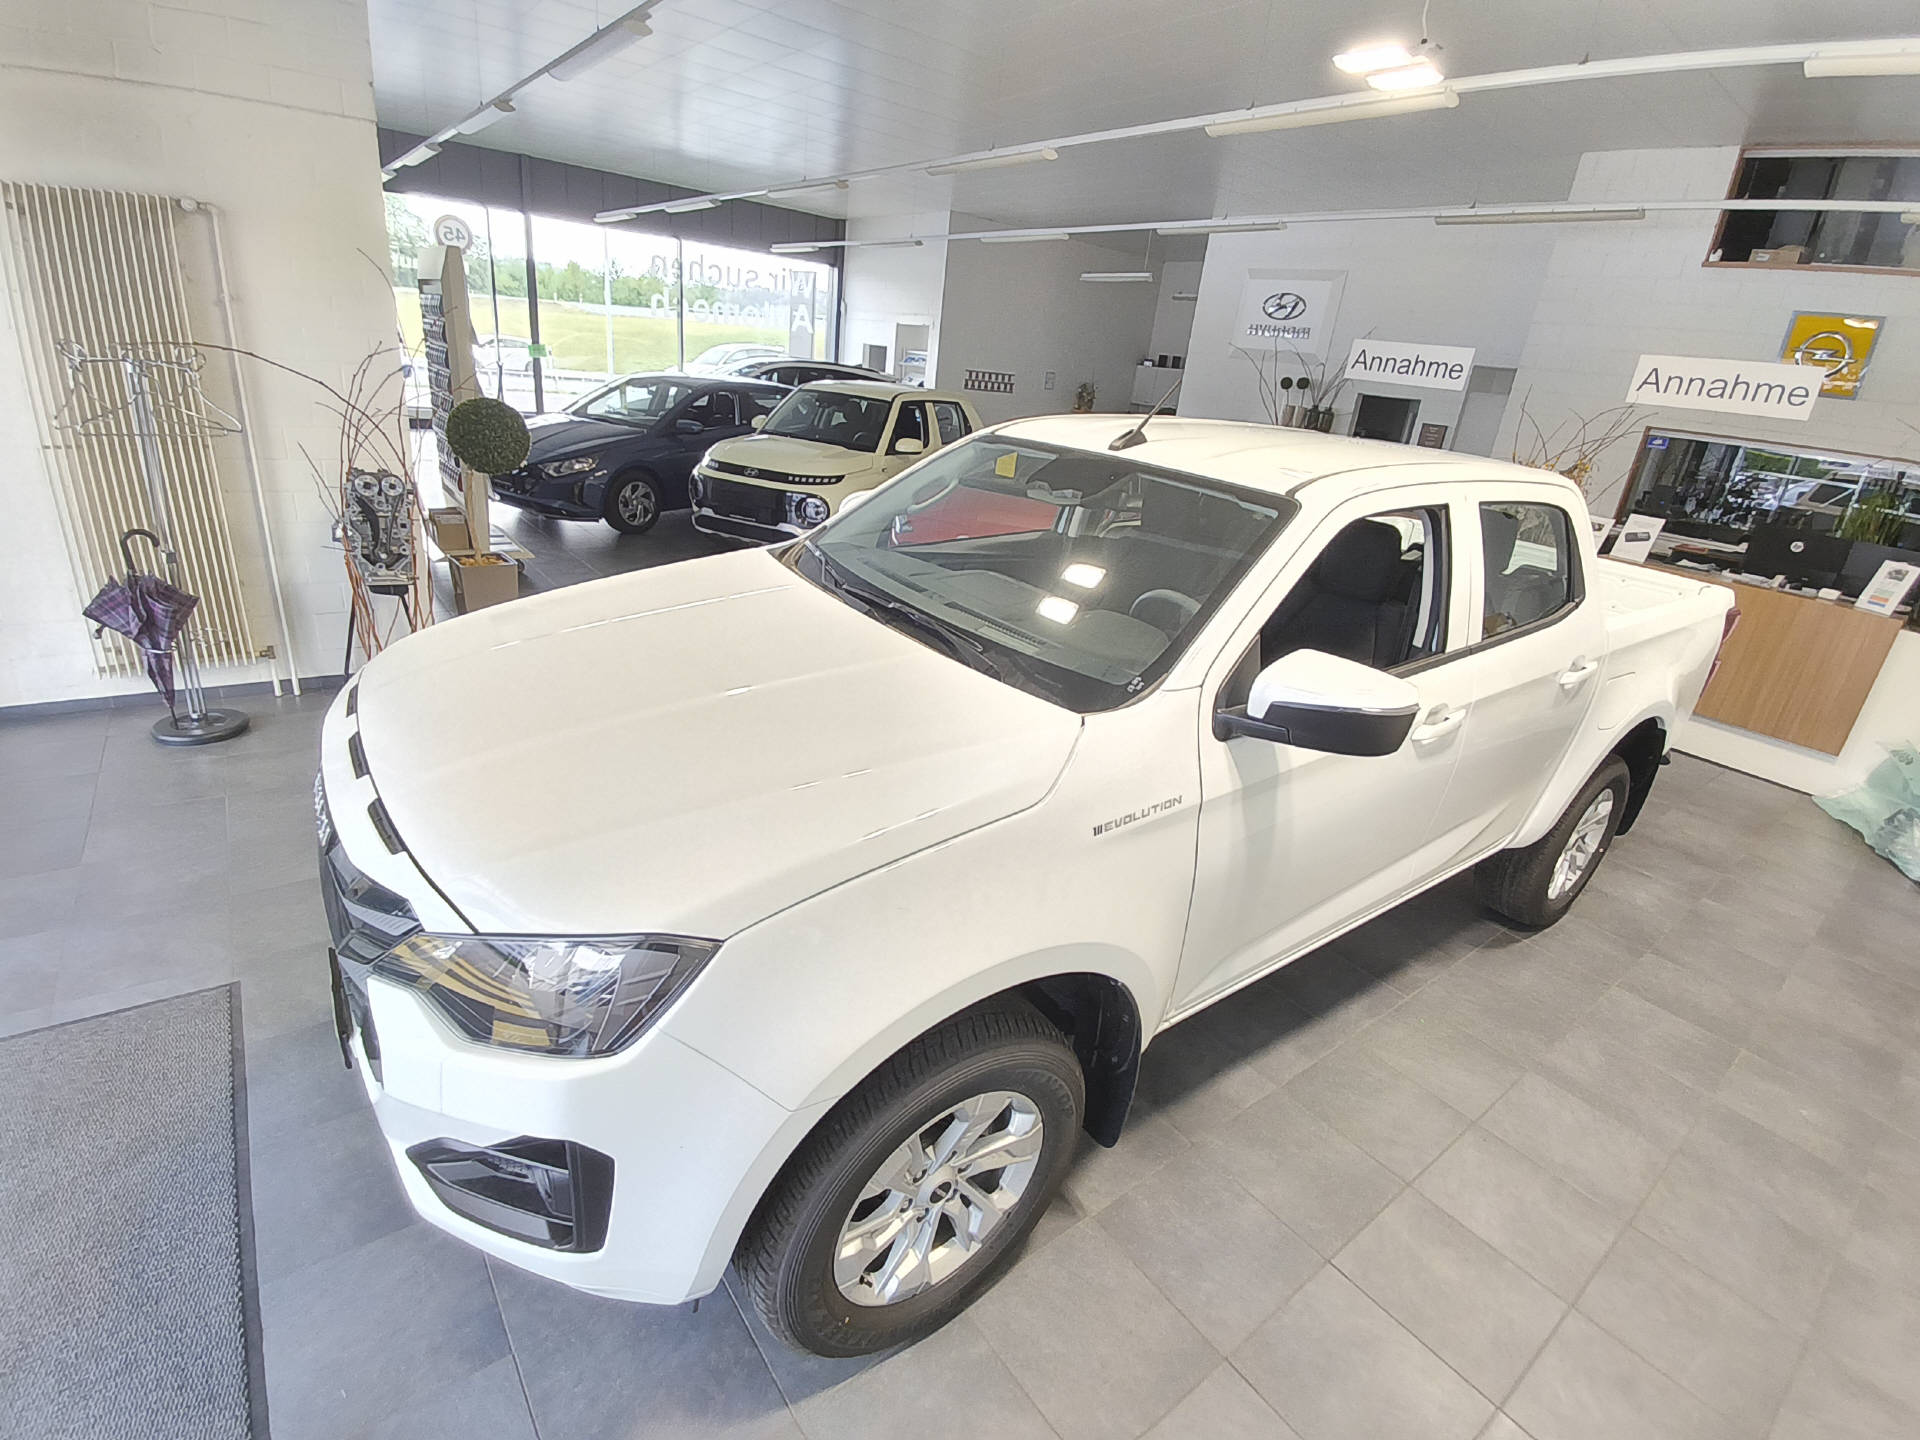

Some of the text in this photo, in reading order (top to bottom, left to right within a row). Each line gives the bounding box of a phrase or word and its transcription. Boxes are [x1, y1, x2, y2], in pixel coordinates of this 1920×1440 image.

[1351, 348, 1464, 380] Annahme
[1636, 367, 1810, 407] Annahme
[1103, 795, 1183, 832] EVOLUTION
